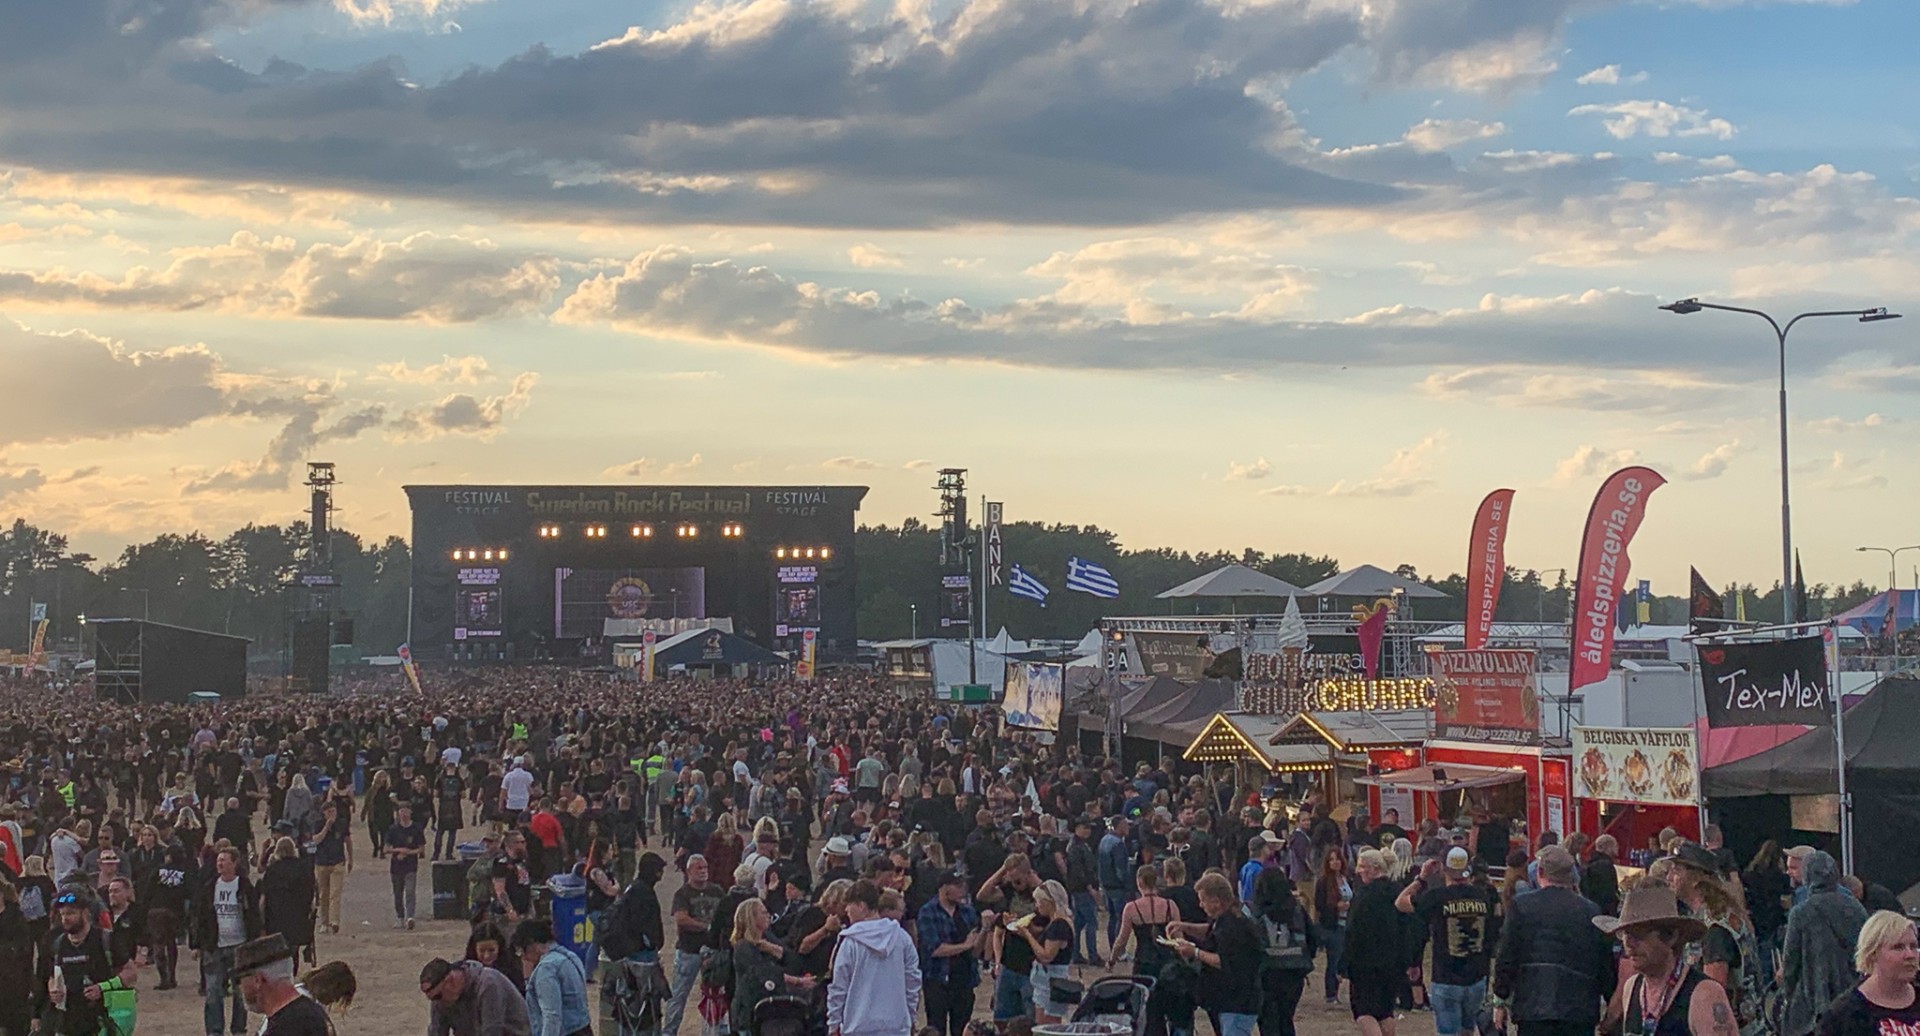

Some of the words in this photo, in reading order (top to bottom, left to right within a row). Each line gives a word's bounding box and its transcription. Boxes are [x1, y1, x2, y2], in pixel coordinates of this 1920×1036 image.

[445, 491, 511, 504] FESTIVAL
[527, 492, 609, 513] Sweden
[614, 491, 663, 513] Rock
[669, 491, 751, 513] Festival
[766, 491, 829, 504] FESTIVAL
[455, 506, 500, 516] STAGE
[776, 506, 818, 516] STAGE
[988, 503, 1002, 586] BANK
[1580, 477, 1643, 664] åledspizzeria.se
[1440, 652, 1532, 675] PIZZARULLAR
[1717, 668, 1824, 711] Tex-Mex
[1583, 730, 1639, 746] BELGISKA
